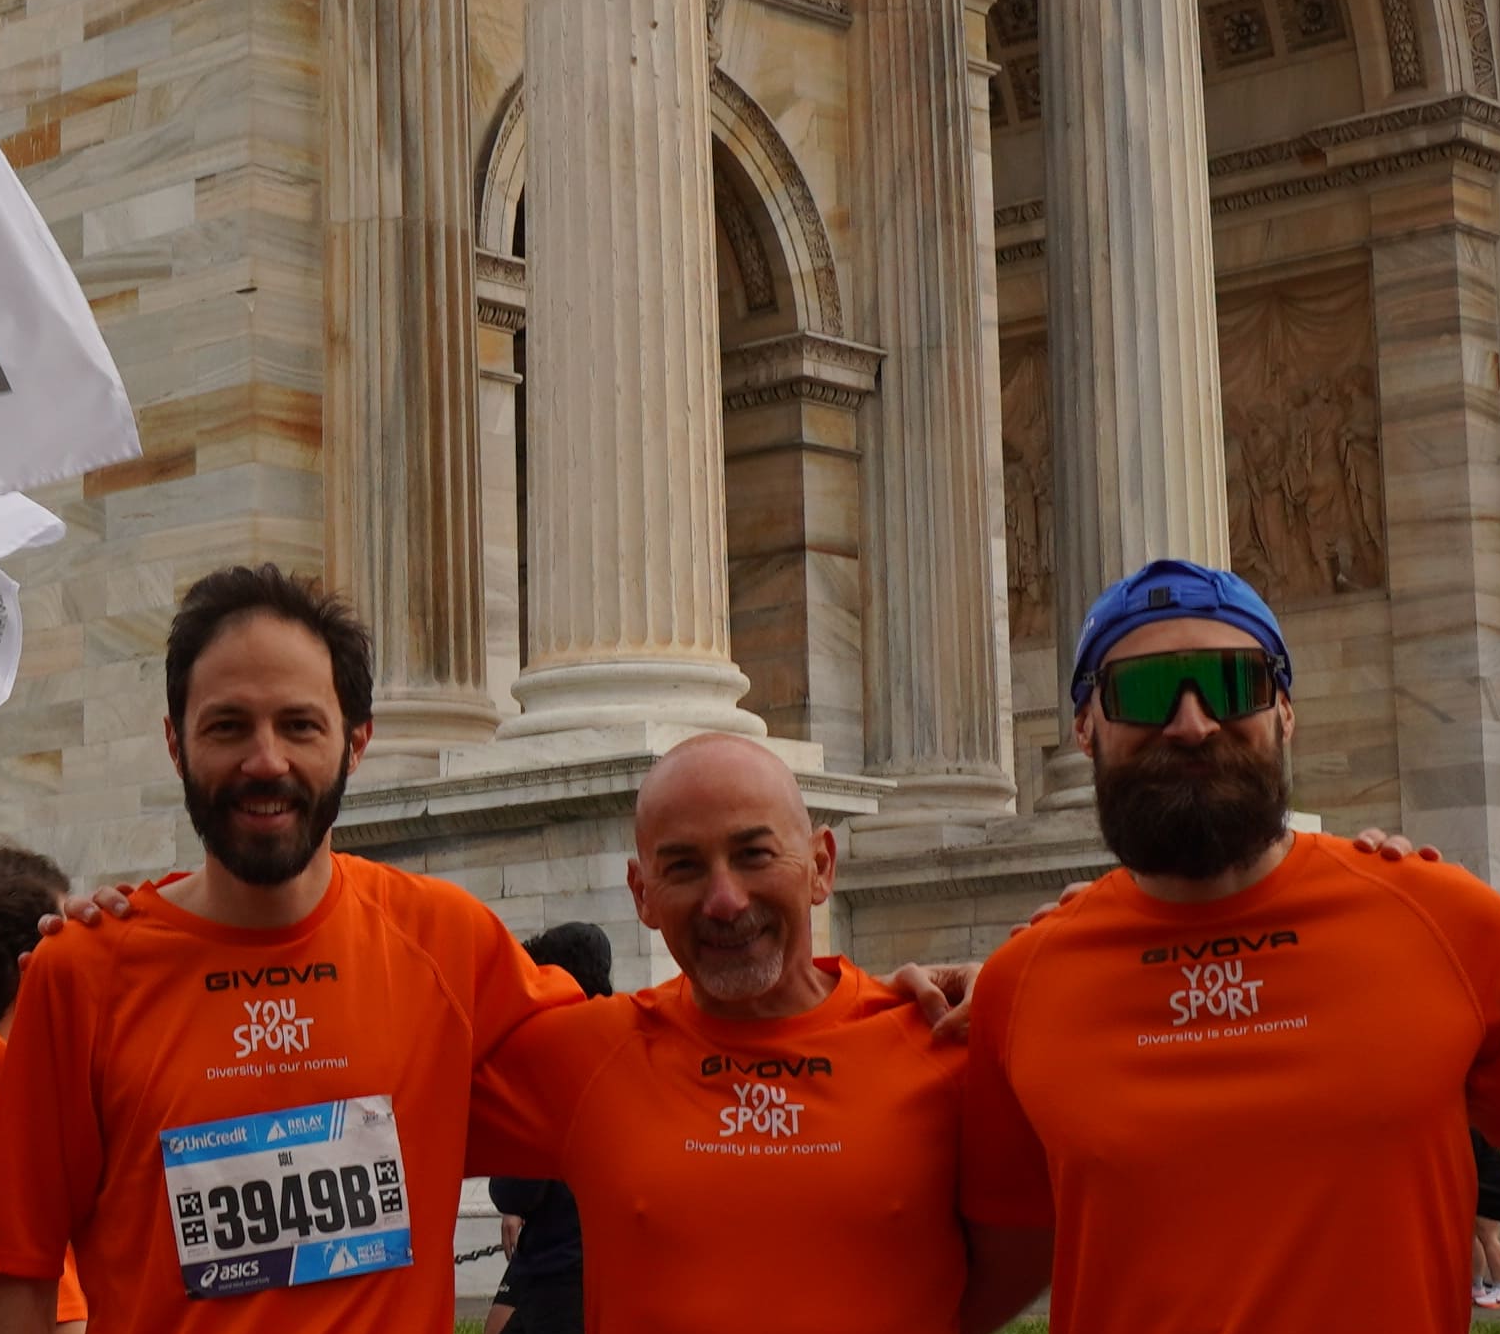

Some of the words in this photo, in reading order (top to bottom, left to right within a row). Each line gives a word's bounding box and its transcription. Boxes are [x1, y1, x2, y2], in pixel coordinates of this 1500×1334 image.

[1141, 931, 1298, 964] GIVOVA
[205, 962, 338, 993] GIVOVA
[1181, 960, 1242, 995] YOU
[243, 998, 296, 1029] YOU
[1170, 980, 1263, 1026] SPORT
[233, 1017, 314, 1058] SPORT
[1137, 1031, 1202, 1047] Diversity
[1208, 1027, 1219, 1040] is
[1224, 1025, 1248, 1037] our
[1254, 1015, 1308, 1034] normal
[207, 1061, 263, 1080] Diversity
[265, 1061, 277, 1074] is
[279, 1060, 301, 1073] our
[304, 1056, 348, 1070] normal
[701, 1055, 833, 1078] GIVOVA
[733, 1083, 786, 1115] YOU
[184, 1127, 249, 1152] UniCredit
[287, 1114, 324, 1130] RELAY
[719, 1104, 804, 1139] SPORT
[685, 1139, 746, 1156] Diversity
[749, 1143, 760, 1155] is
[765, 1144, 788, 1155] our
[792, 1141, 842, 1154] normal
[207, 1165, 378, 1252] 3949B
[219, 1260, 260, 1281] asics
